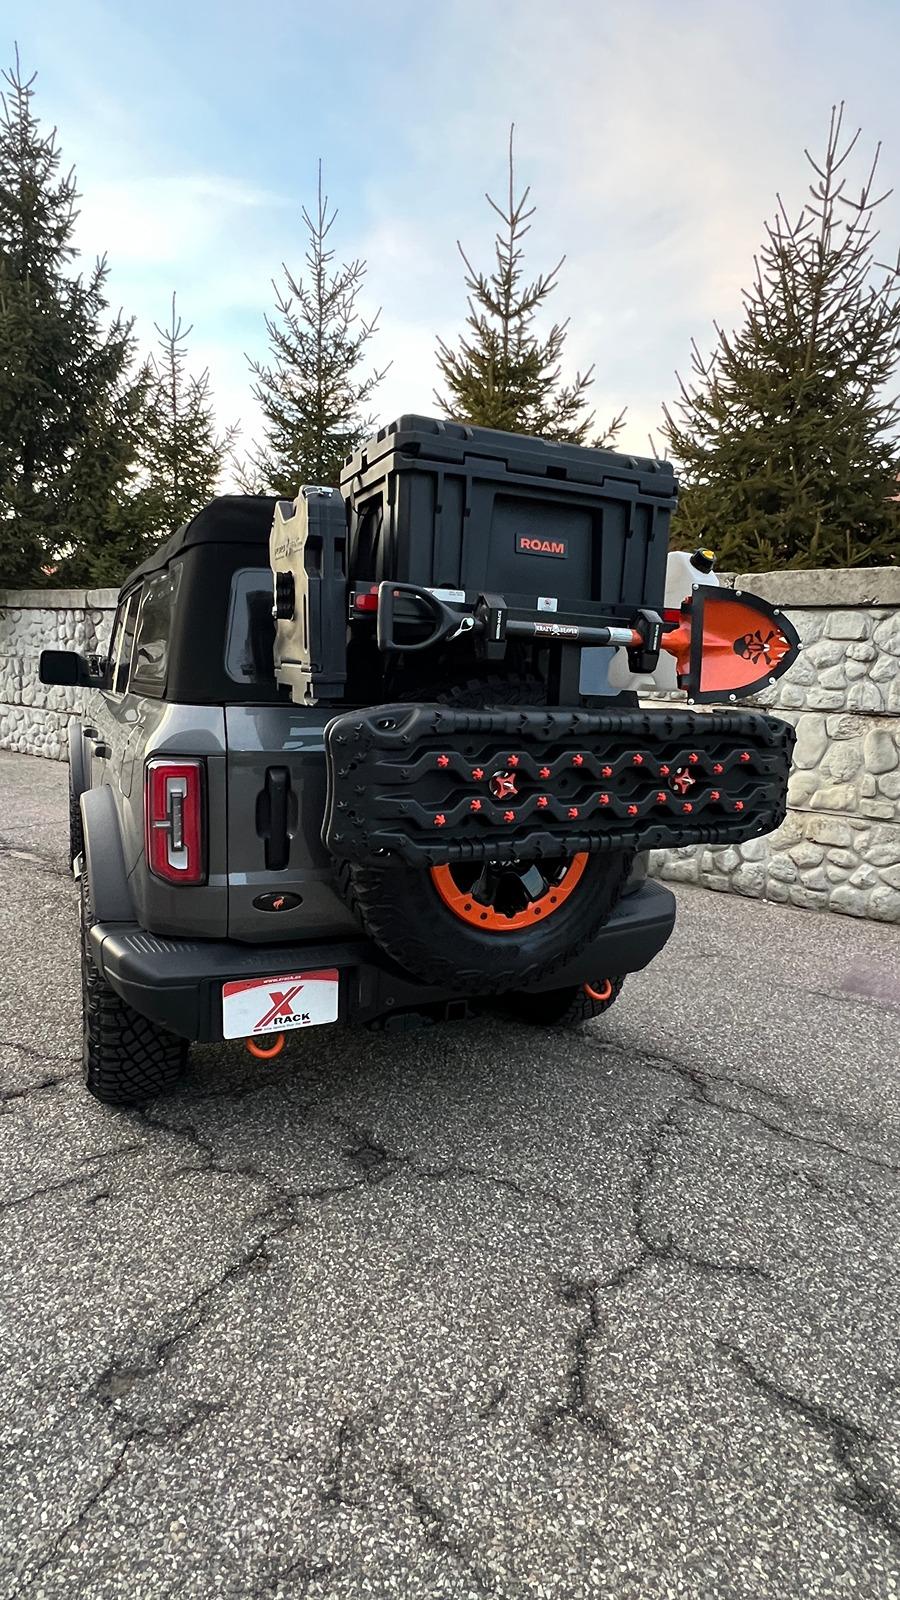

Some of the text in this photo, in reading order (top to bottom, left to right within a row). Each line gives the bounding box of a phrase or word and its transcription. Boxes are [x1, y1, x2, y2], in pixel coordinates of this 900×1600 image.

[520, 538, 564, 554] ROAM
[254, 985, 304, 1028] X
[274, 1012, 310, 1025] RACK
